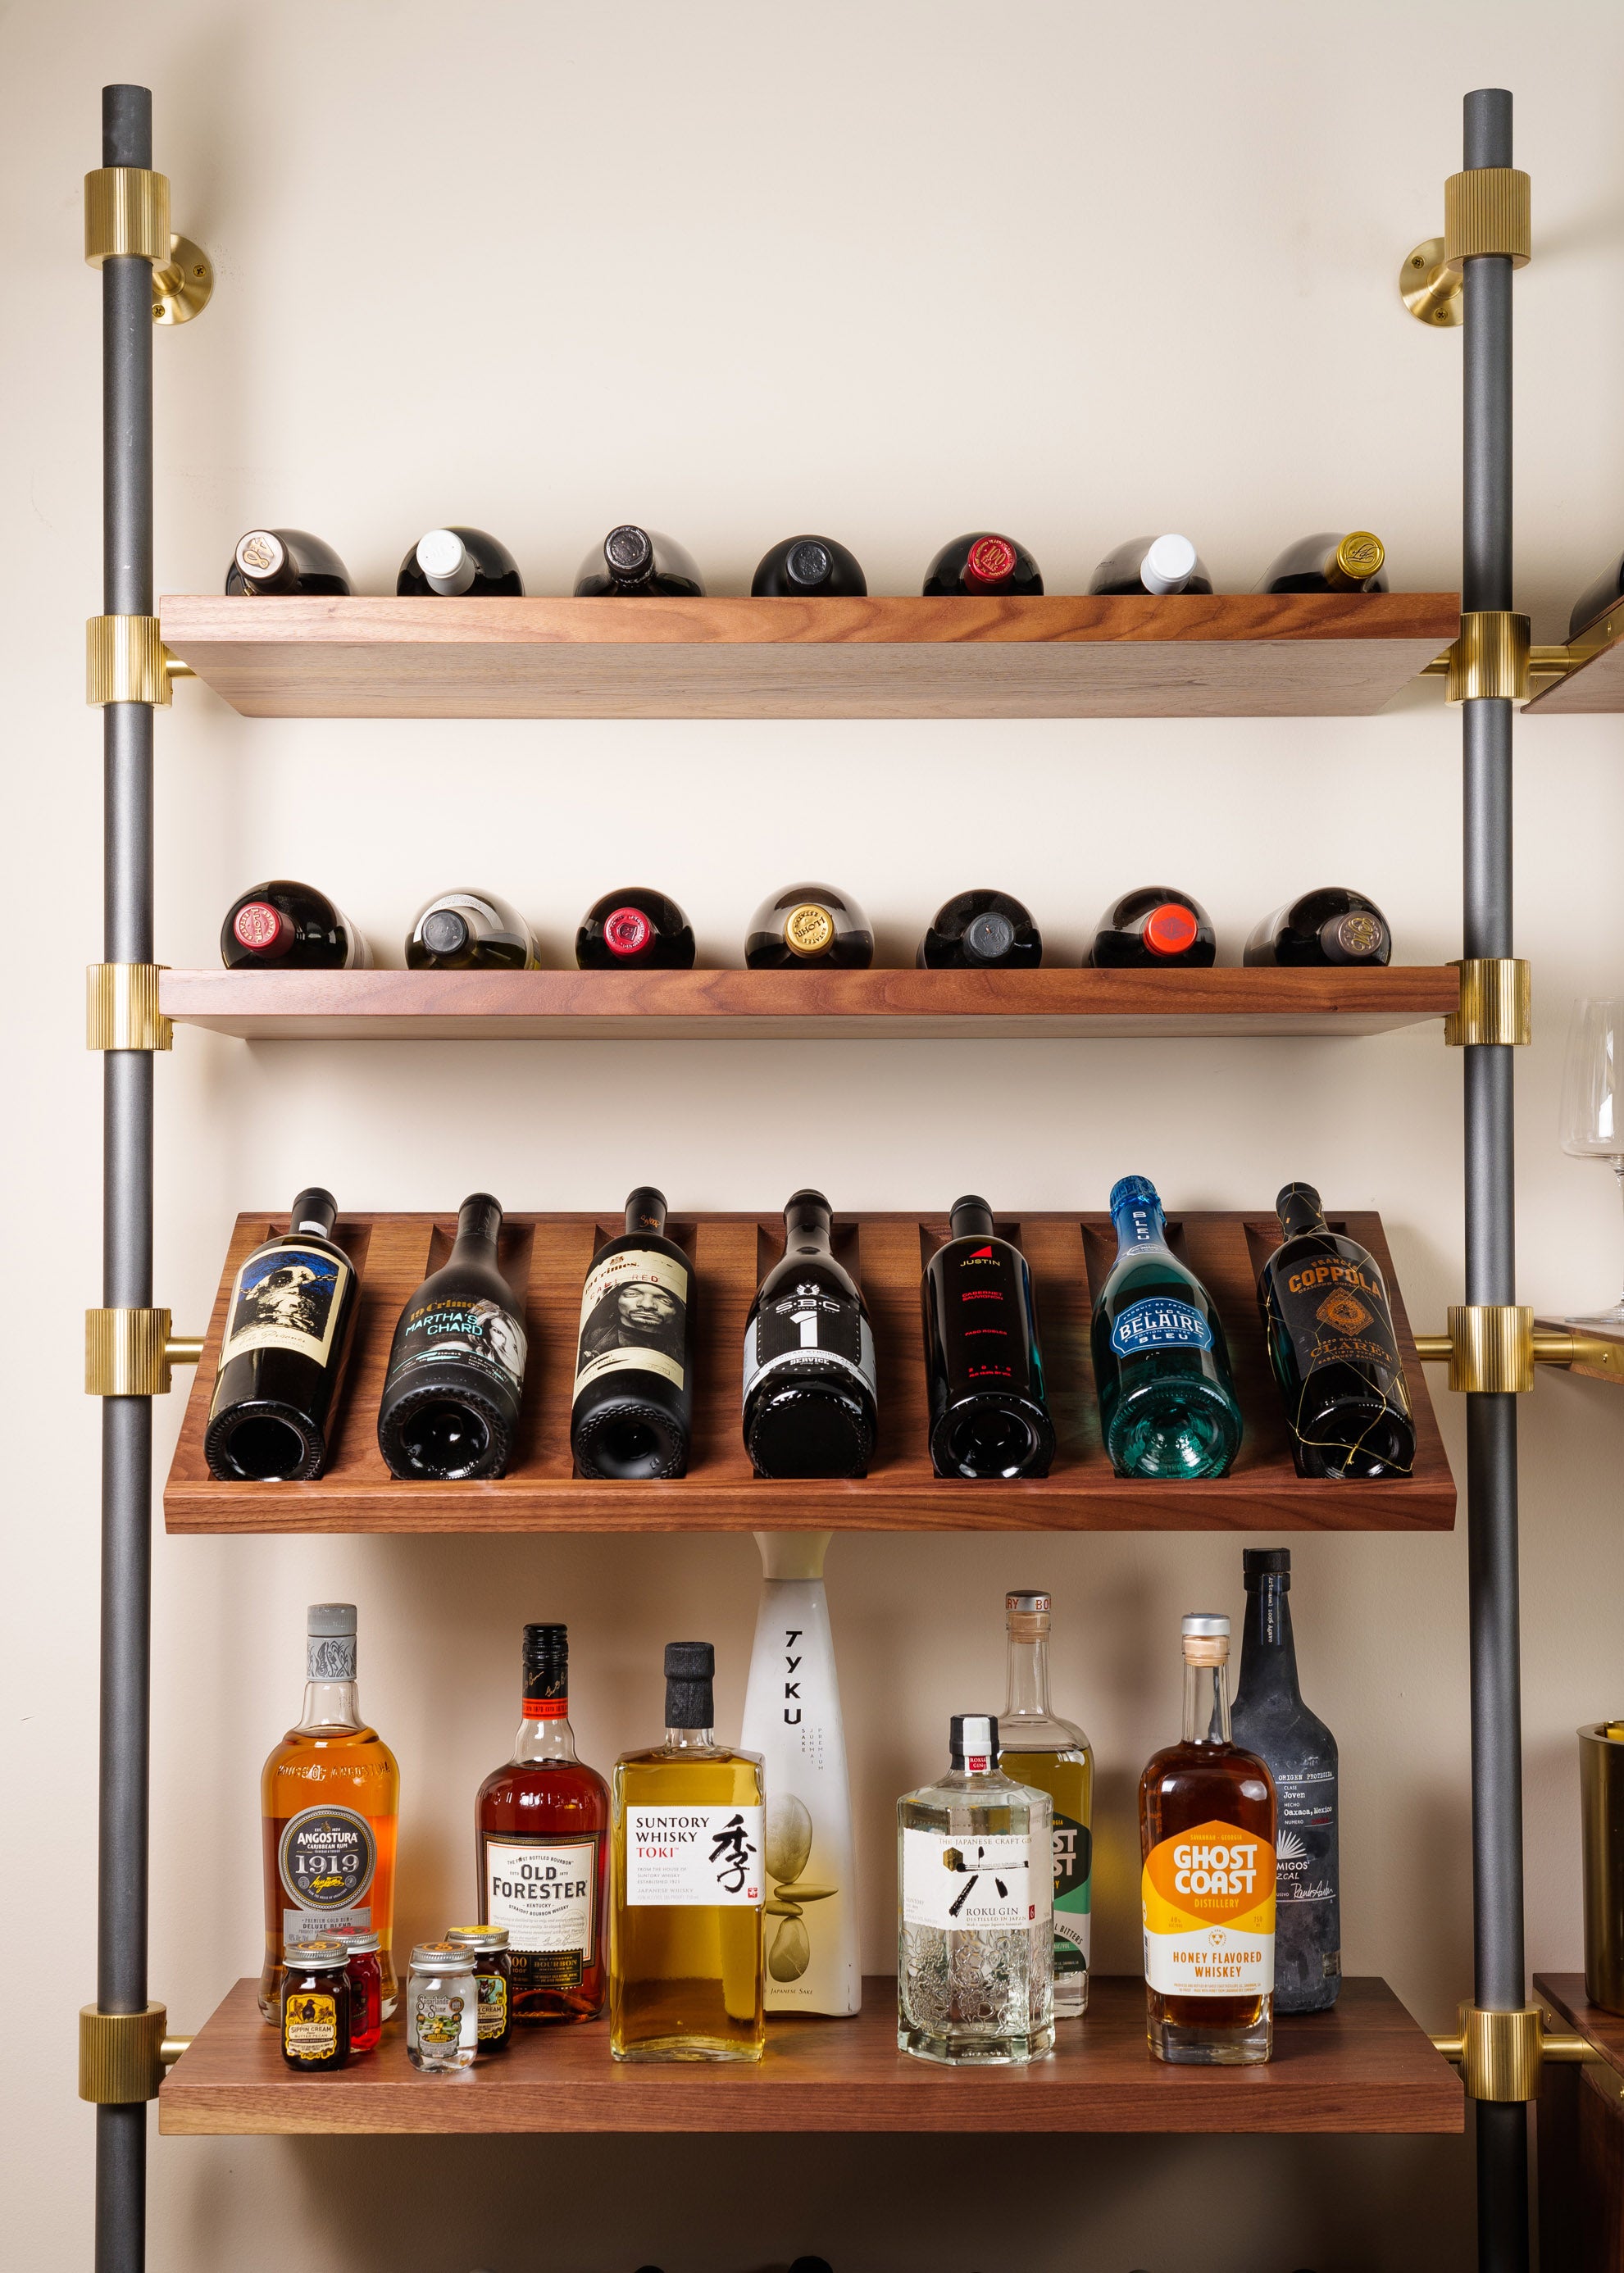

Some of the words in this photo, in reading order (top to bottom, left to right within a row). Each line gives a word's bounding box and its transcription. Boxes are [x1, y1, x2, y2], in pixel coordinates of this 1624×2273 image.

[985, 545, 1007, 566] 100
[1132, 1211, 1150, 1240] BLEU
[960, 1258, 1001, 1267] JUSTIN
[1311, 1258, 1358, 1271] FRANCIS
[631, 1274, 659, 1283] RED
[1288, 1266, 1383, 1301] COPPOLA
[410, 1307, 425, 1322] 19
[1123, 1304, 1152, 1321] PRODUIT
[1168, 1303, 1196, 1316] FRANCE
[405, 1312, 478, 1337] MARTHA'S
[427, 1322, 483, 1336] CHARD
[789, 1311, 818, 1348] 1
[1118, 1313, 1205, 1341] BELAIRE
[1139, 1333, 1189, 1344] BLEU
[1310, 1341, 1394, 1363] CLARET
[789, 1357, 830, 1366] SERVICE
[1283, 1791, 1306, 1799] Joven
[1284, 1808, 1313, 1816] Oaxaca,
[1313, 1806, 1333, 1814] Mexico
[635, 1816, 710, 1829] SUNTORY
[297, 1832, 358, 1845] ANGOSTURA
[635, 1831, 698, 1843] WHISKY
[954, 1838, 993, 1846] JAPANESE
[708, 1813, 757, 1894] 季
[1173, 1844, 1258, 1870] GHOST
[295, 1853, 360, 1875] 1919
[550, 1856, 572, 1866] BOURBON
[1276, 1862, 1308, 1871] MIGOS
[521, 1863, 557, 1881] OLD
[1276, 1872, 1300, 1880] ZCAL
[493, 1876, 587, 1900] FORESTER
[1174, 1869, 1258, 1895] COAST
[1194, 1898, 1240, 1908] DISTILLERY
[508, 1904, 530, 1916] STRAIGHT
[552, 1904, 570, 1914] WHISKY
[966, 1907, 996, 1916] ROKU
[999, 1907, 1019, 1916] GIN
[1059, 1924, 1083, 1945] BITTERS
[509, 1956, 527, 1968] 00
[534, 1959, 578, 1968] BOURBON
[1172, 1951, 1208, 1964] HONEY
[1212, 1951, 1262, 1964] FLAVORED
[1194, 1966, 1242, 1978] WHISKEY
[290, 2025, 310, 2034] SIPPIN
